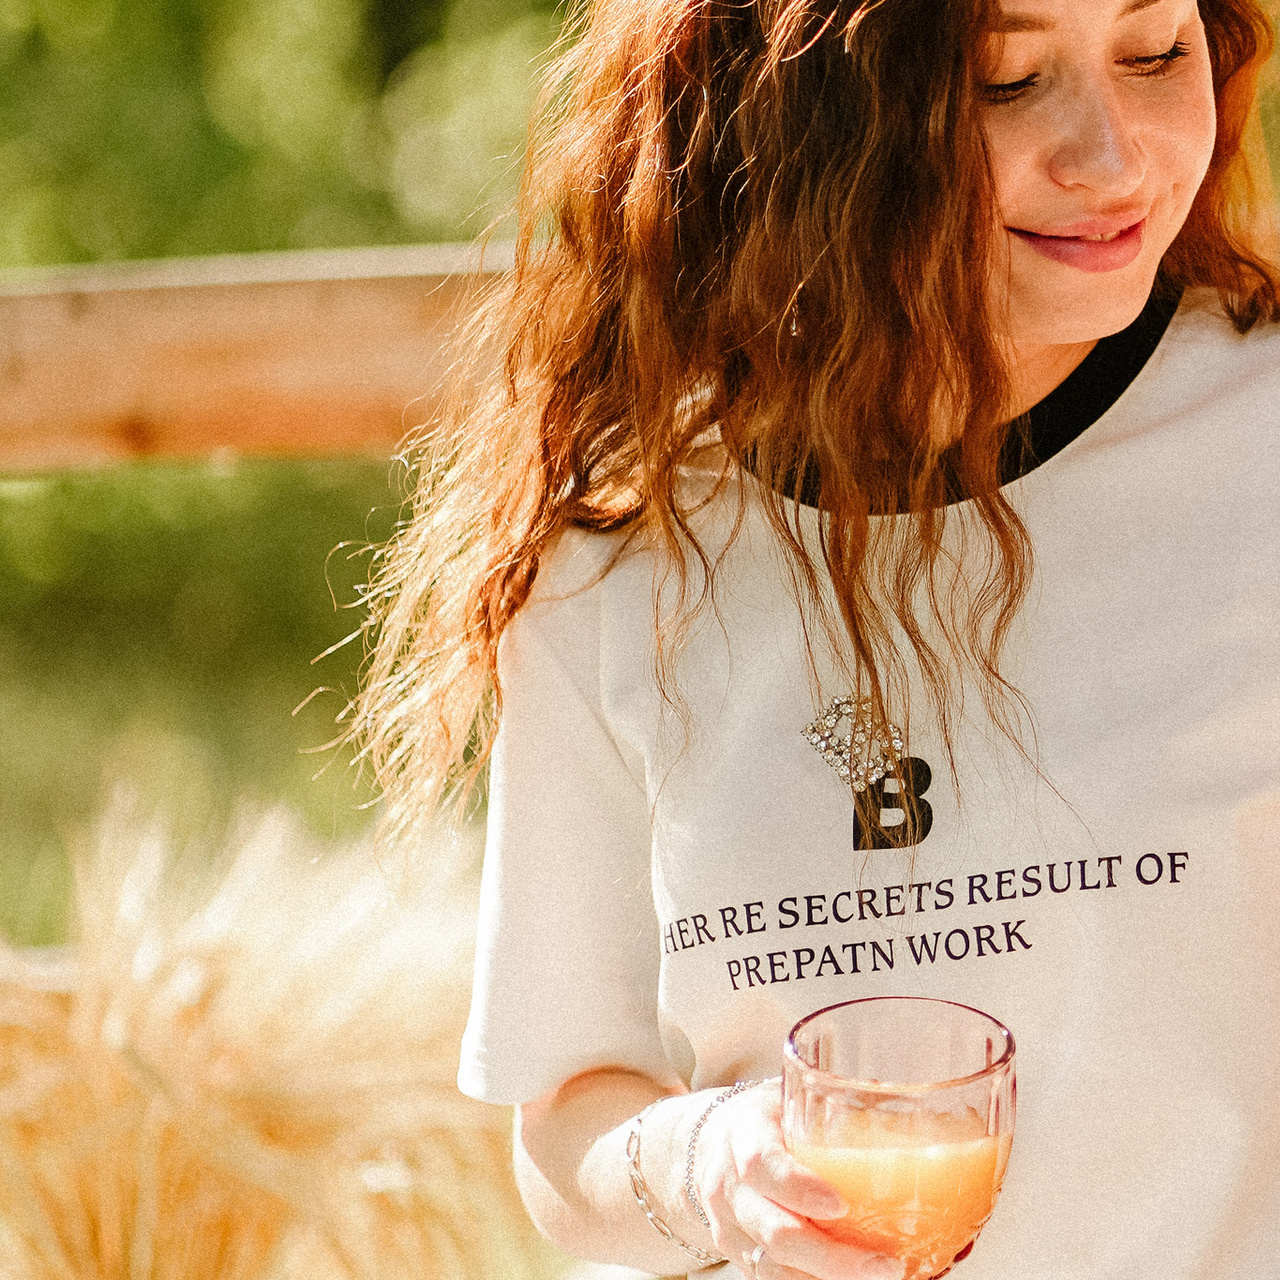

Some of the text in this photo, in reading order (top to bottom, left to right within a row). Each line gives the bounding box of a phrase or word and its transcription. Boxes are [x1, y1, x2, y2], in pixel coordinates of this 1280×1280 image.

[853, 757, 933, 851] B
[719, 901, 767, 939] RE
[777, 879, 955, 930] SECRETS
[966, 855, 1122, 906] RESULT
[1135, 851, 1189, 886] OF
[726, 919, 1033, 991] PREPATN WORK
